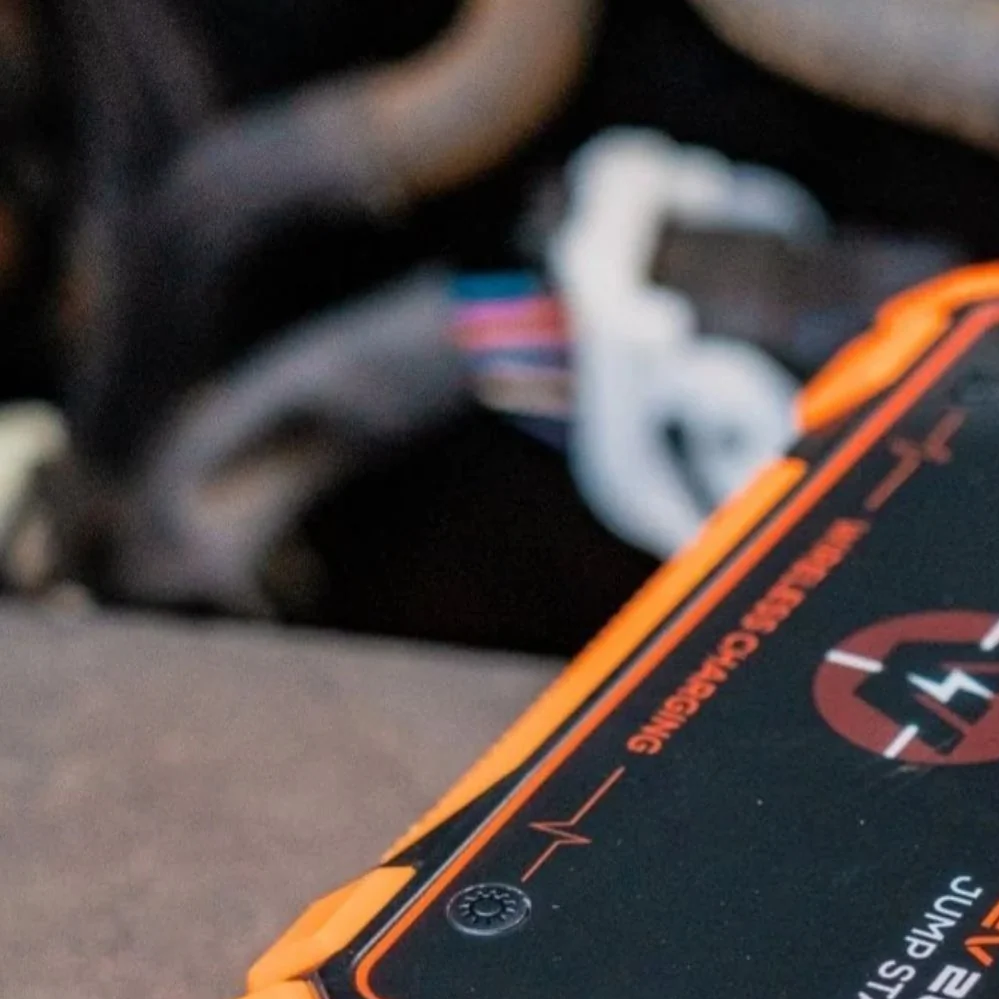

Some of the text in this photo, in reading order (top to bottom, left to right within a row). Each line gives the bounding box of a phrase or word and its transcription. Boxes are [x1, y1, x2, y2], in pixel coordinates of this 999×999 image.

[626, 516, 870, 755] WIRELESS CHARGING
[904, 874, 983, 960] JUMP
